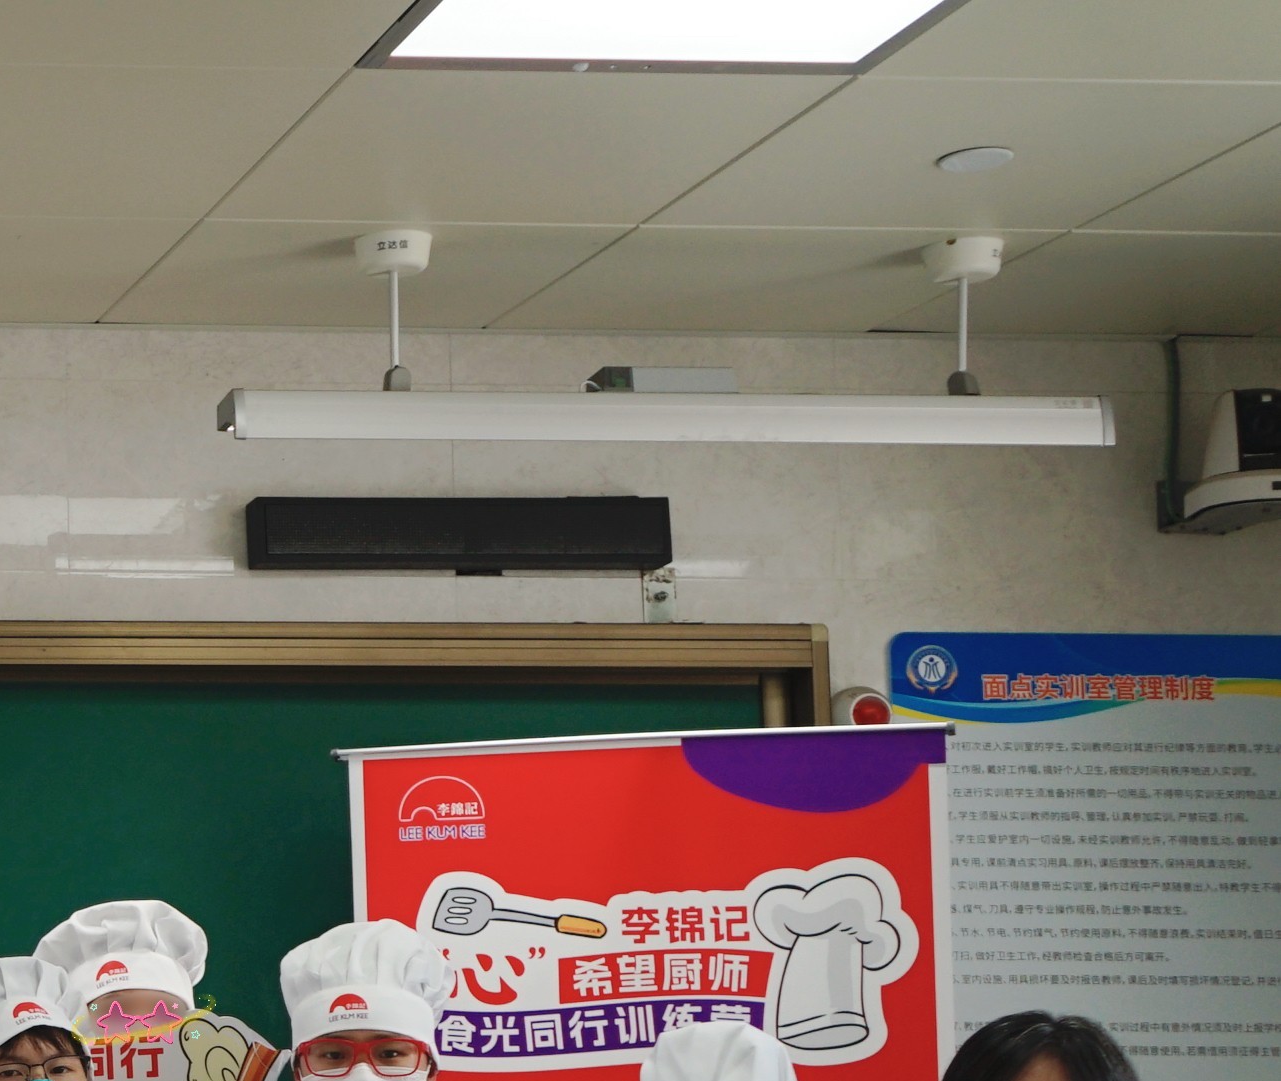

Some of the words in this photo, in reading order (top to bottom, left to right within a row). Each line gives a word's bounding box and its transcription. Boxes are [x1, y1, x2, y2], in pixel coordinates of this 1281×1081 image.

[377, 240, 408, 251] 立达信
[982, 673, 1216, 701] 面点实训室管理制度
[400, 826, 423, 842] LEE
[426, 825, 456, 840] KUM
[461, 824, 486, 839] KEE
[620, 905, 750, 944] 李锦记
[572, 952, 750, 997] 希望厨师
